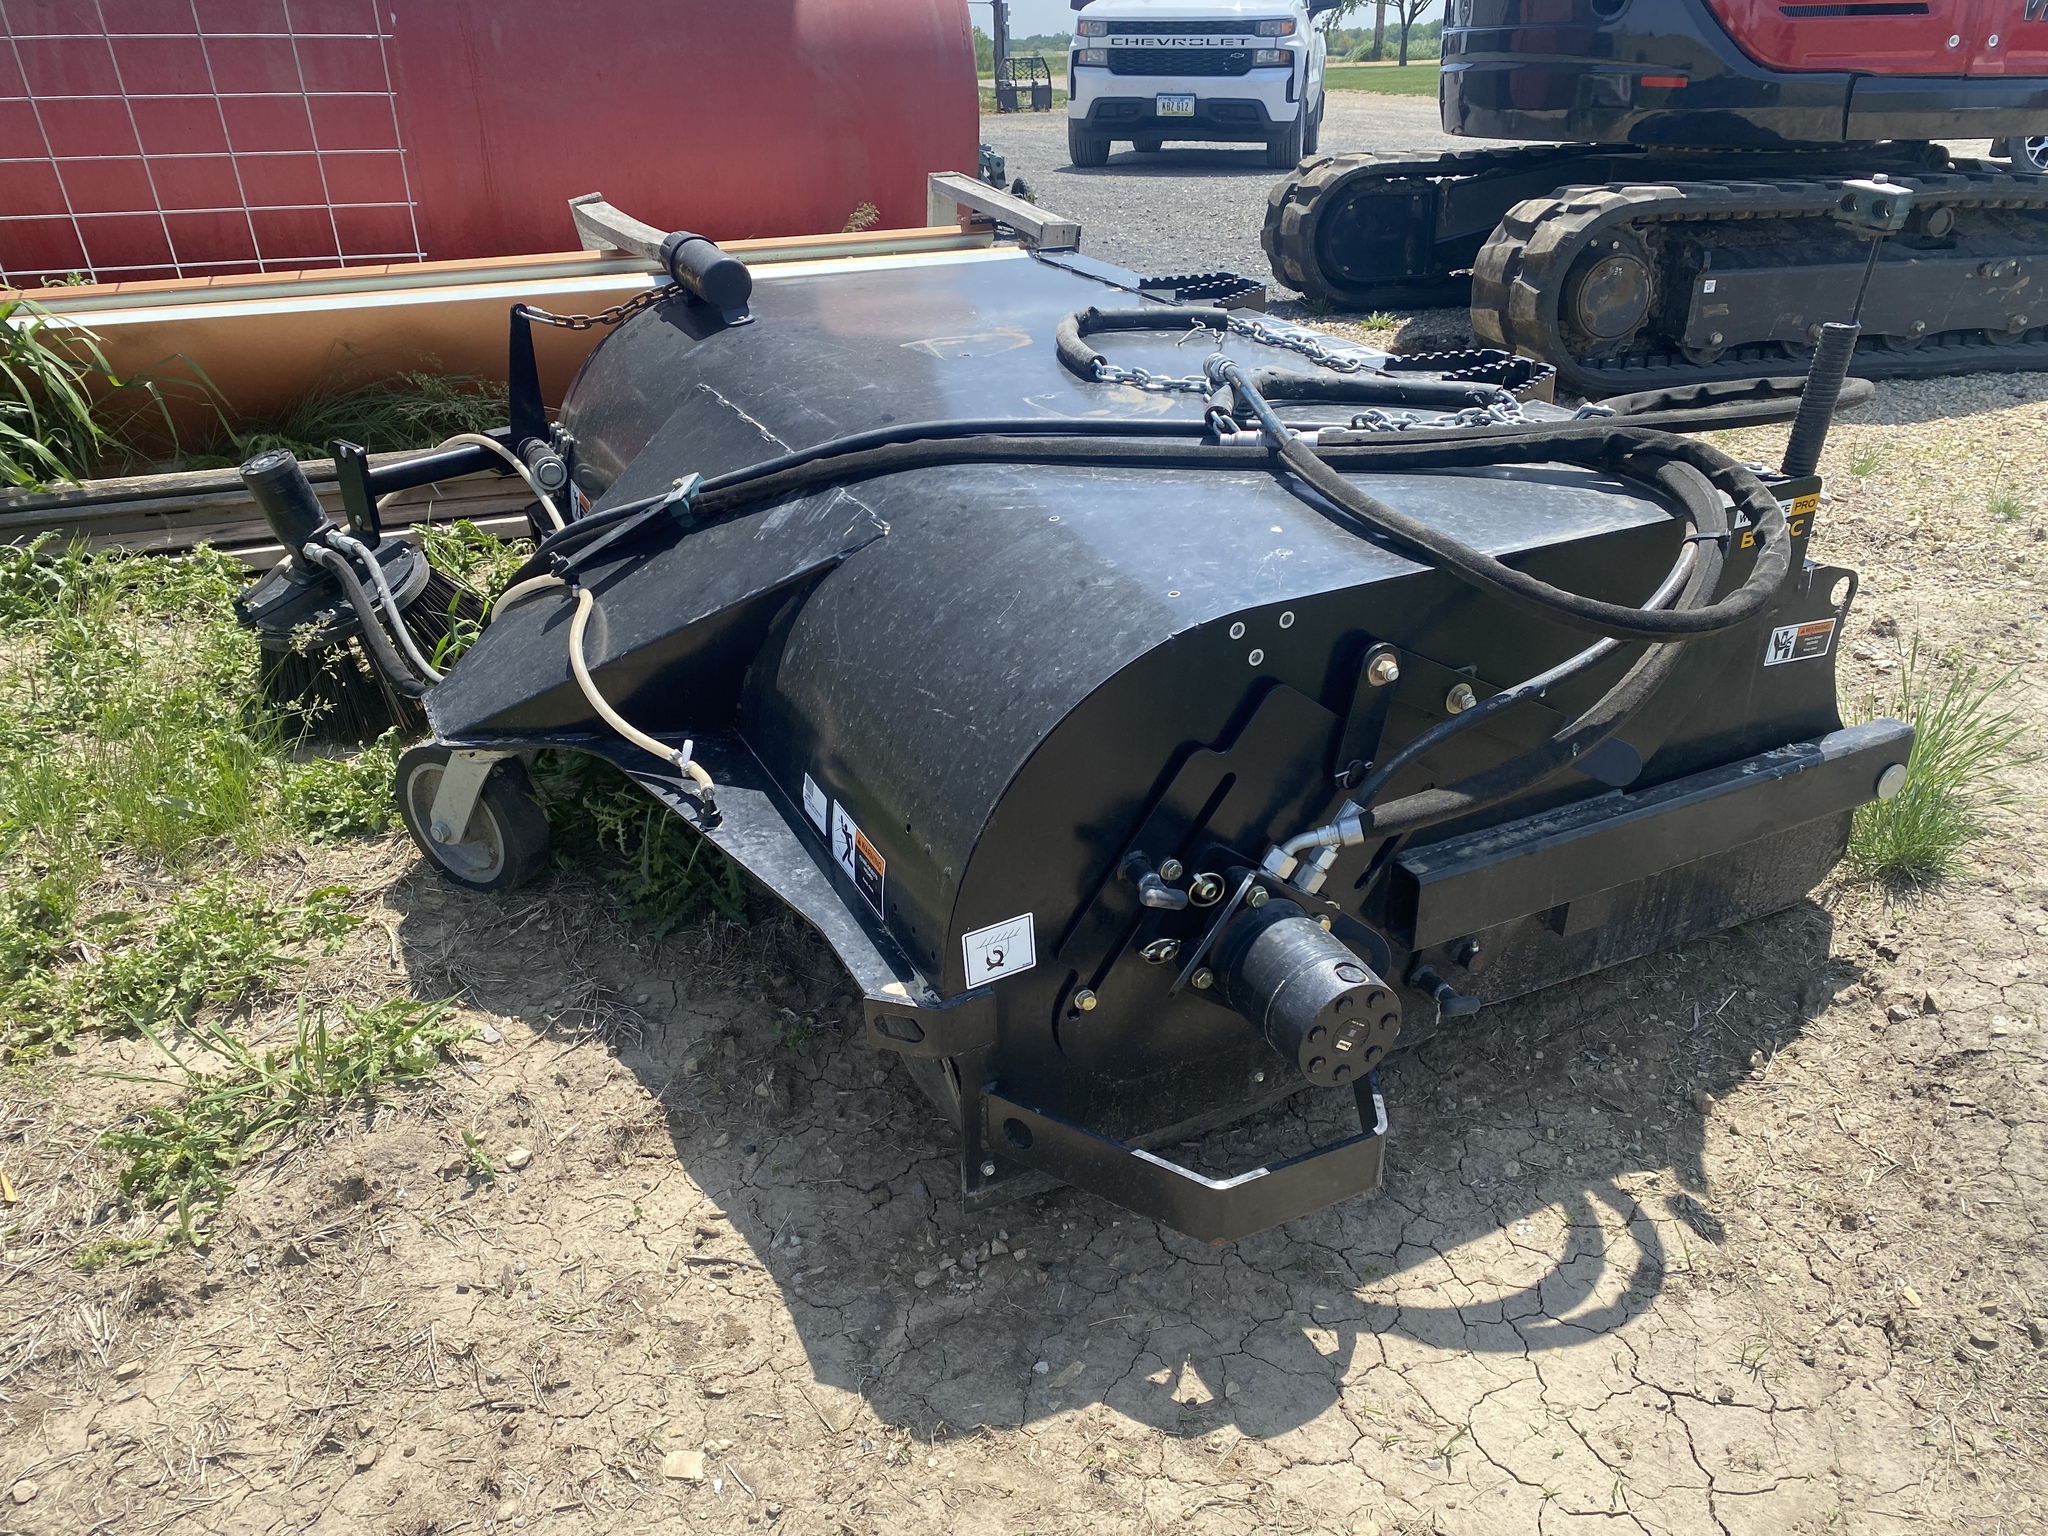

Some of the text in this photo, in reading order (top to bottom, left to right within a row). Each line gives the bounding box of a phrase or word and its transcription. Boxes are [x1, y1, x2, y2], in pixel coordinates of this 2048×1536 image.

[1111, 38, 1250, 46] CHEVROLET
[1176, 101, 1189, 112] 612
[1794, 498, 1816, 511] PRO
